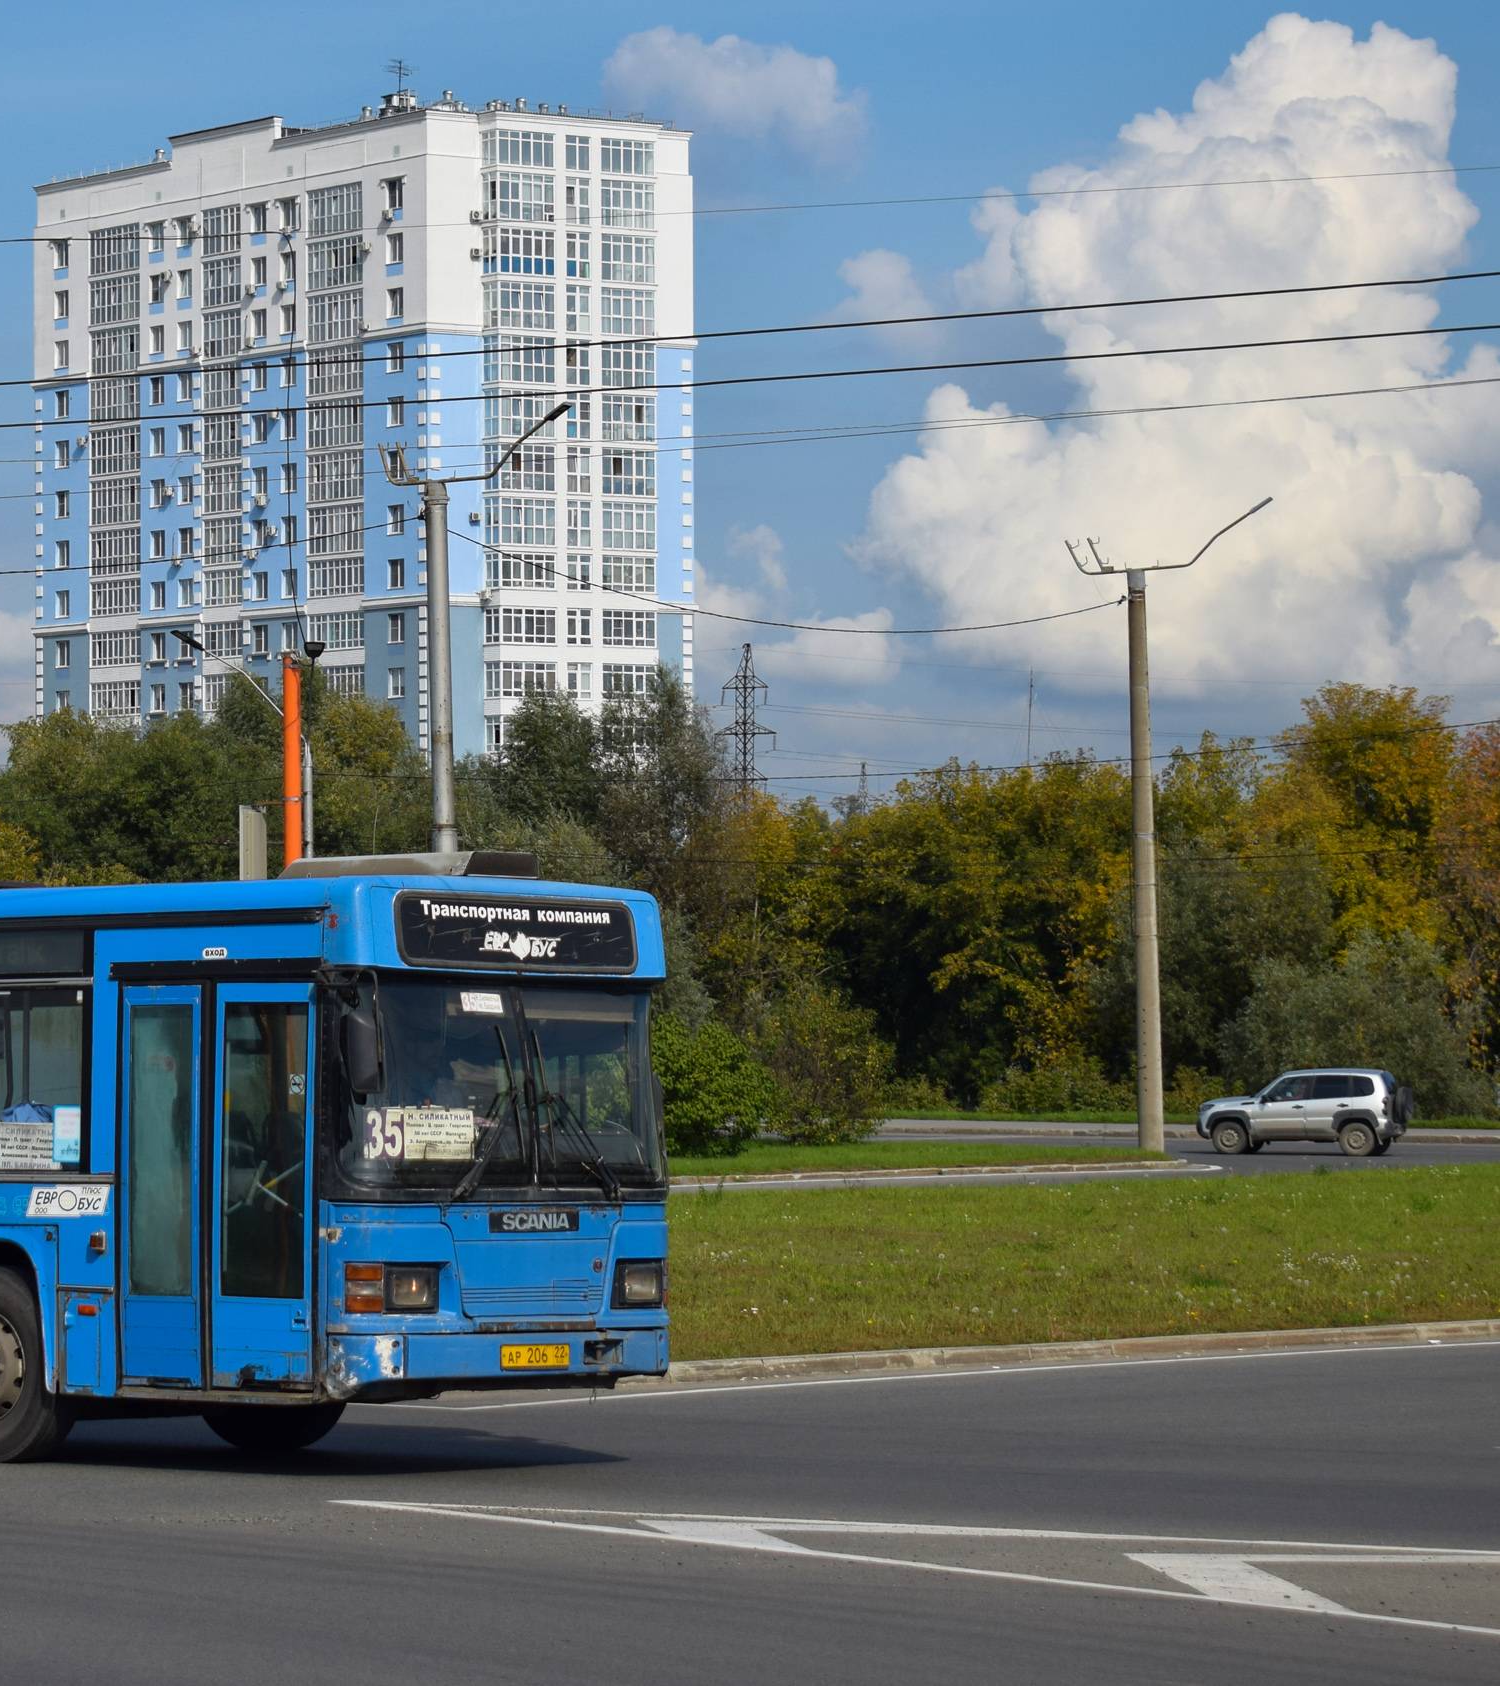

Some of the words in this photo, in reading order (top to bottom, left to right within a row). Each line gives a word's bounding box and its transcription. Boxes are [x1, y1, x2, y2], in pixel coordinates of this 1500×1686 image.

[420, 899, 530, 921] Транспортная
[537, 909, 610, 924] компания
[205, 949, 224, 957] ВХОД
[5, 1127, 53, 1136] СИЛИКАТНЫ
[366, 1108, 404, 1158] 35
[502, 1212, 569, 1230] SCANIA
[527, 1347, 548, 1364] 206
[554, 1345, 565, 1359] 22
